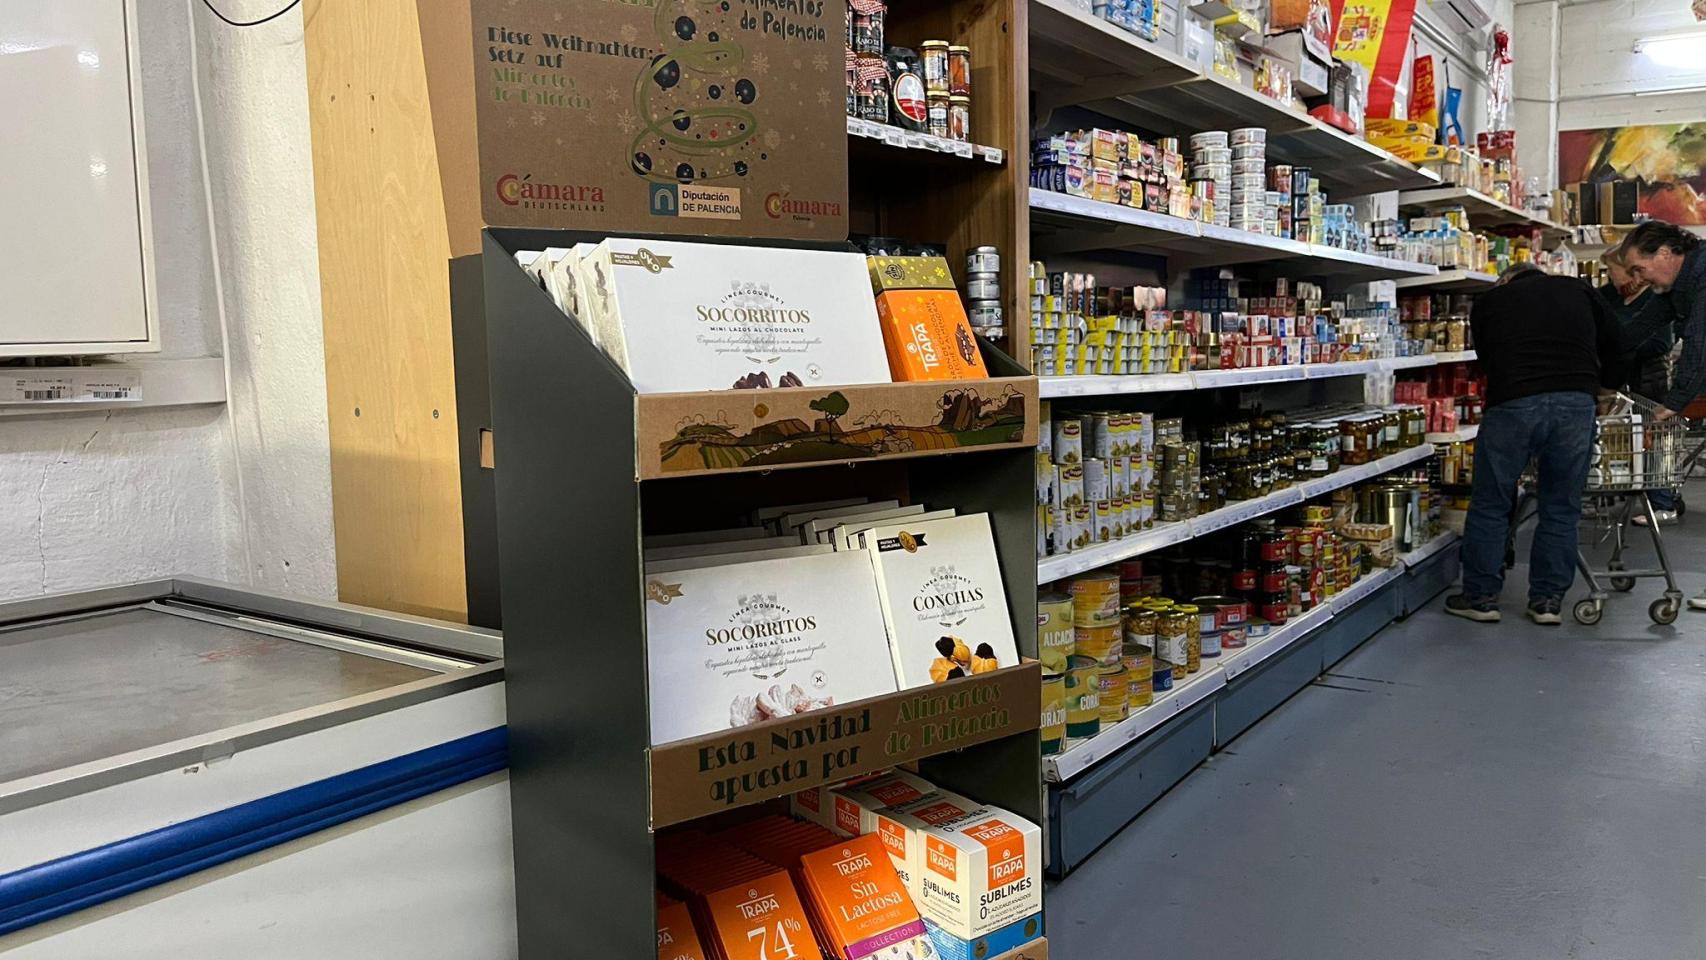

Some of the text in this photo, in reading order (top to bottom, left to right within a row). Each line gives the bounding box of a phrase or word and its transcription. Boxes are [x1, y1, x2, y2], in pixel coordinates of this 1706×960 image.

[487, 26, 533, 46] Diese
[741, 10, 826, 41] de Palencia
[488, 46, 565, 68] Setz auf
[497, 174, 605, 206] Cámara
[682, 189, 730, 203] Diputación
[524, 202, 605, 212] DEUTSCHLAND
[682, 203, 741, 215] DE PALENCIA
[764, 192, 841, 219] Cámara
[746, 289, 785, 305] GOURMET
[696, 304, 811, 324] SOCORRITOS
[910, 323, 940, 373] TRAPA
[940, 574, 972, 585] GOURMET
[753, 603, 792, 615] GOURMET
[913, 587, 984, 612] CONCHAS
[706, 615, 817, 646] SOCORRITOS
[746, 641, 767, 650] LAZOS
[780, 636, 801, 644] CLASS
[698, 684, 1001, 773] Esta Navidad Alimentos
[708, 707, 1011, 806] apuesta por de Palencia
[837, 807, 860, 831] TRAPA
[920, 807, 961, 822] TRAPA
[933, 809, 989, 829] SUBLIMES
[879, 827, 905, 852] TRAPA
[971, 825, 1014, 841] TRAPA
[832, 853, 873, 877] TRAPA
[927, 847, 956, 873] TRAPA
[989, 854, 1024, 881] TRAPA
[851, 880, 880, 900] Sin
[923, 878, 960, 904] SUBLIMES
[980, 877, 1032, 906] SUBLIMES
[736, 893, 780, 920] TRAPA
[840, 890, 904, 922] Lactosa
[857, 914, 886, 930] LACTOSE
[864, 927, 914, 950] COLLECTION
